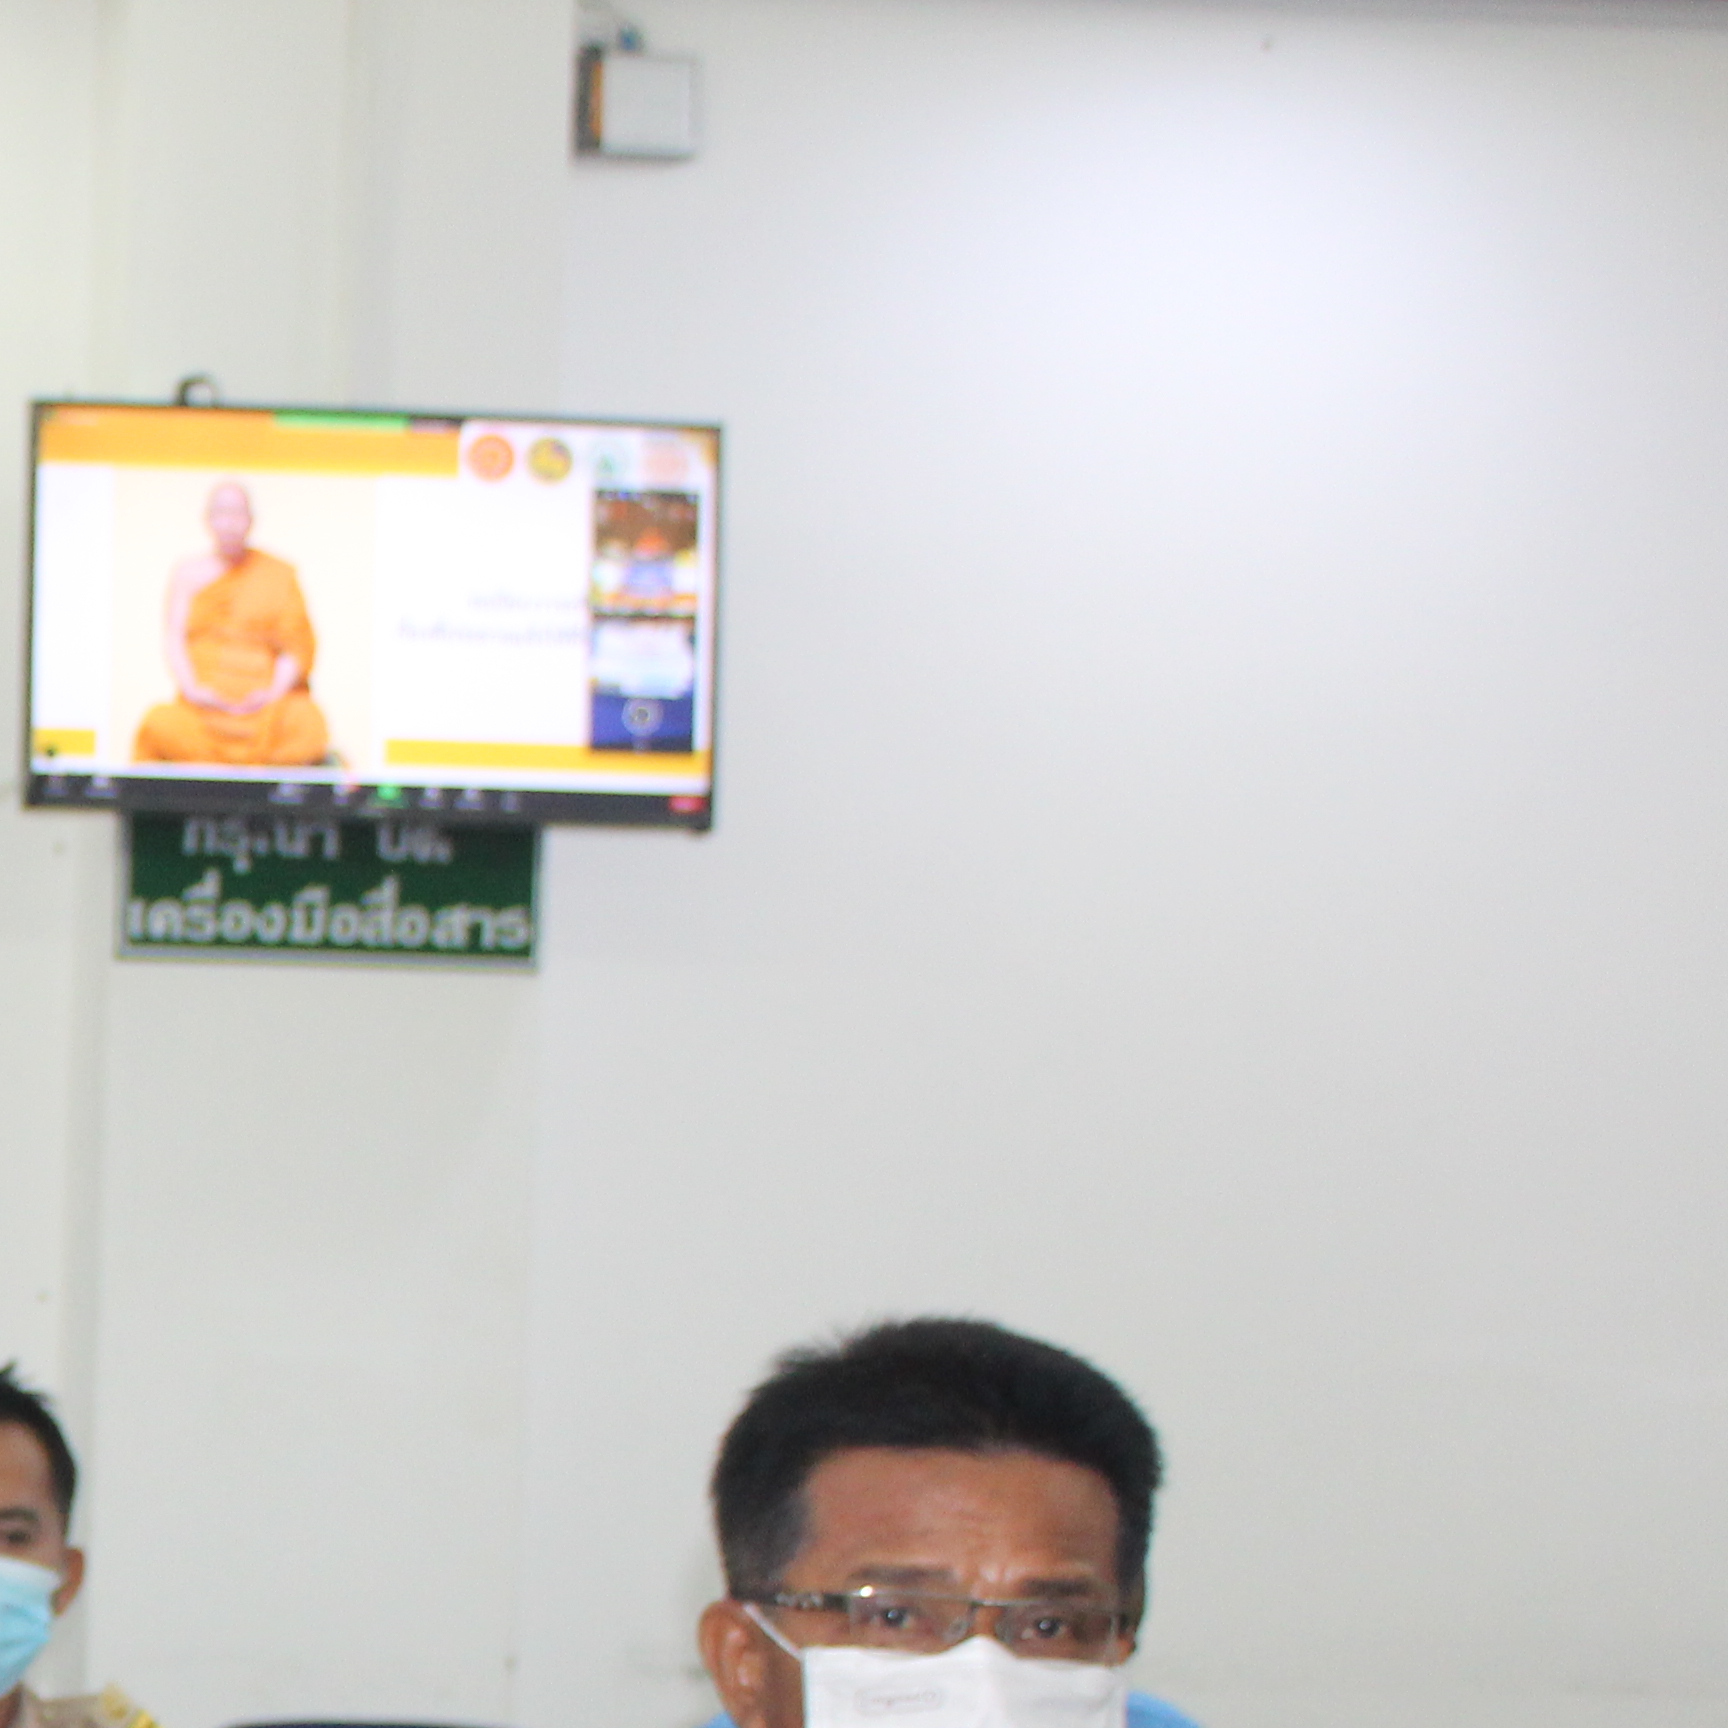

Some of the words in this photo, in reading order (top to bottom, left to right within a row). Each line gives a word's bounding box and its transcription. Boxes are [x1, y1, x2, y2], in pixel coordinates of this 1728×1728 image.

[126, 865, 532, 952] เครื่องมือสื่อสาร
